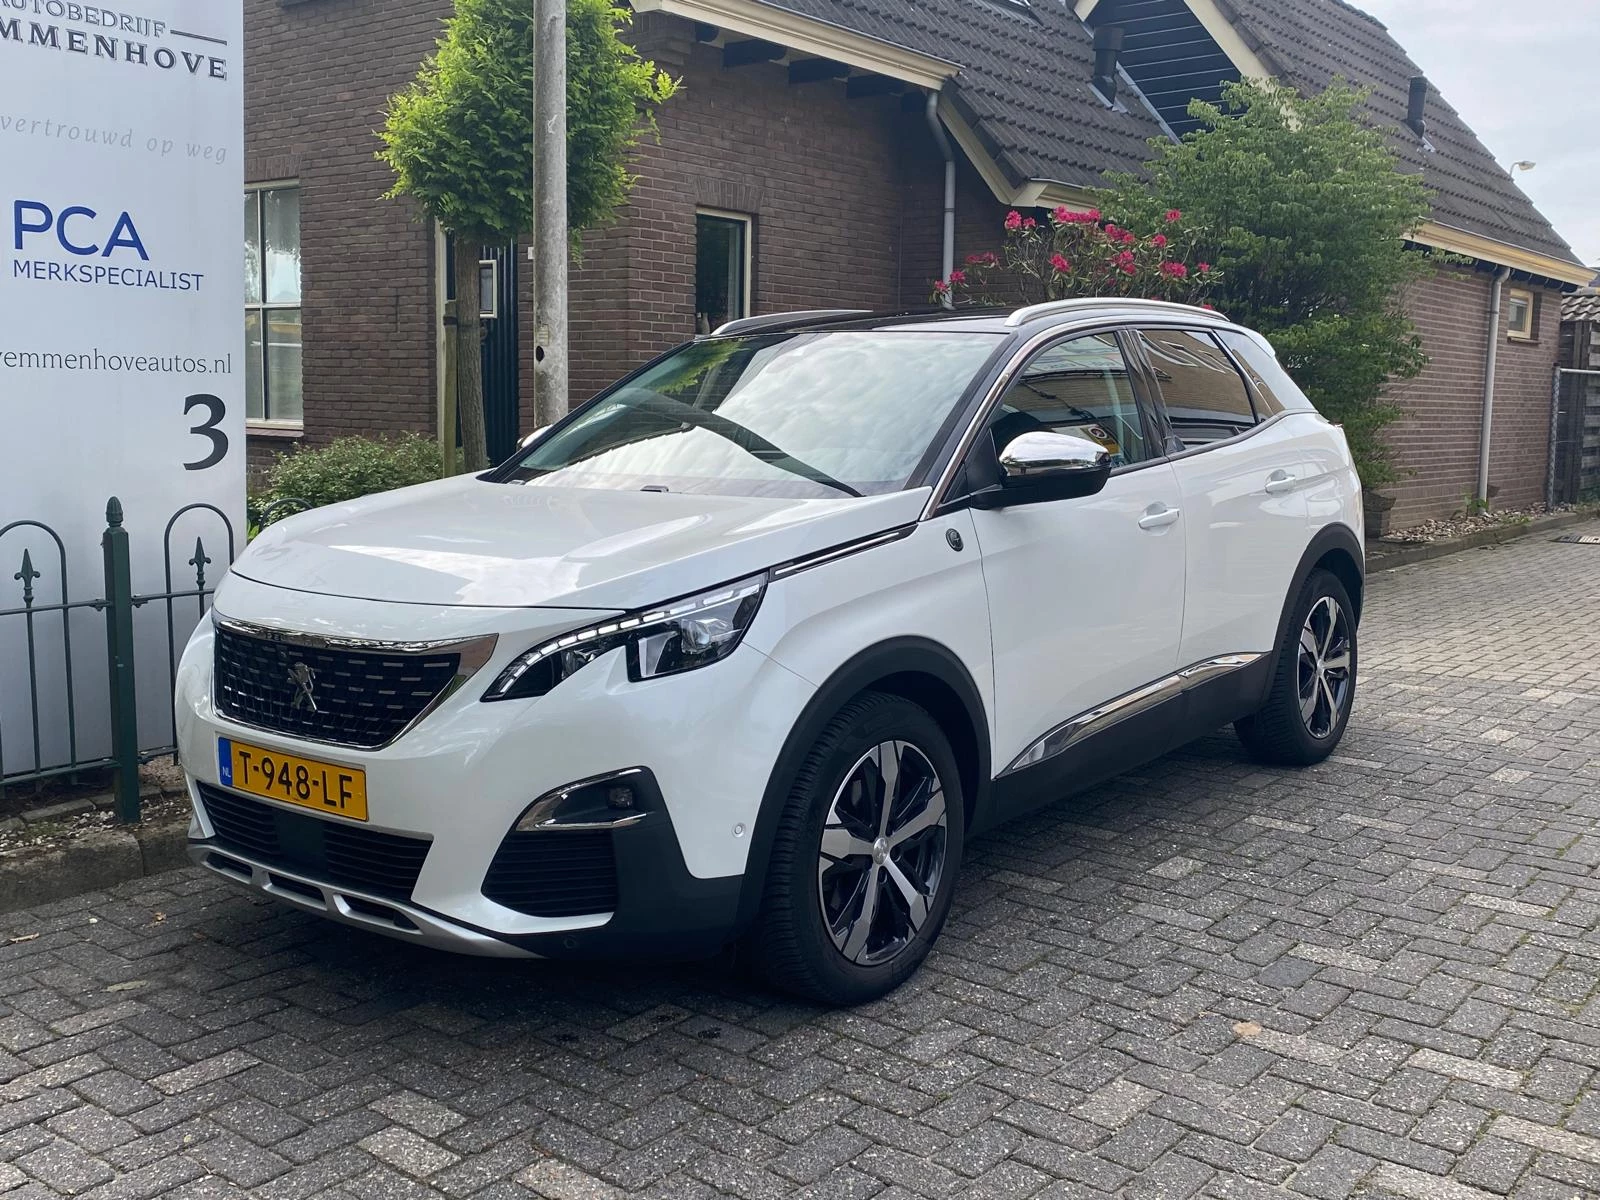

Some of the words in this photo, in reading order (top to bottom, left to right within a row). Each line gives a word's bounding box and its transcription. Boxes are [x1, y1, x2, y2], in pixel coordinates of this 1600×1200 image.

[1, 0, 166, 38] UTOBEDRIJF
[0, 16, 228, 81] MMENHOVE
[1, 115, 133, 148] vertrouwd
[147, 137, 174, 157] op
[187, 143, 227, 165] weg
[14, 199, 150, 261] PCA
[13, 259, 204, 291] MERKSPECIALIST
[0, 348, 231, 374] emmenhoveautos.nl
[183, 393, 229, 471] 3
[222, 767, 232, 778] NL
[239, 750, 353, 809] T-948-LF
